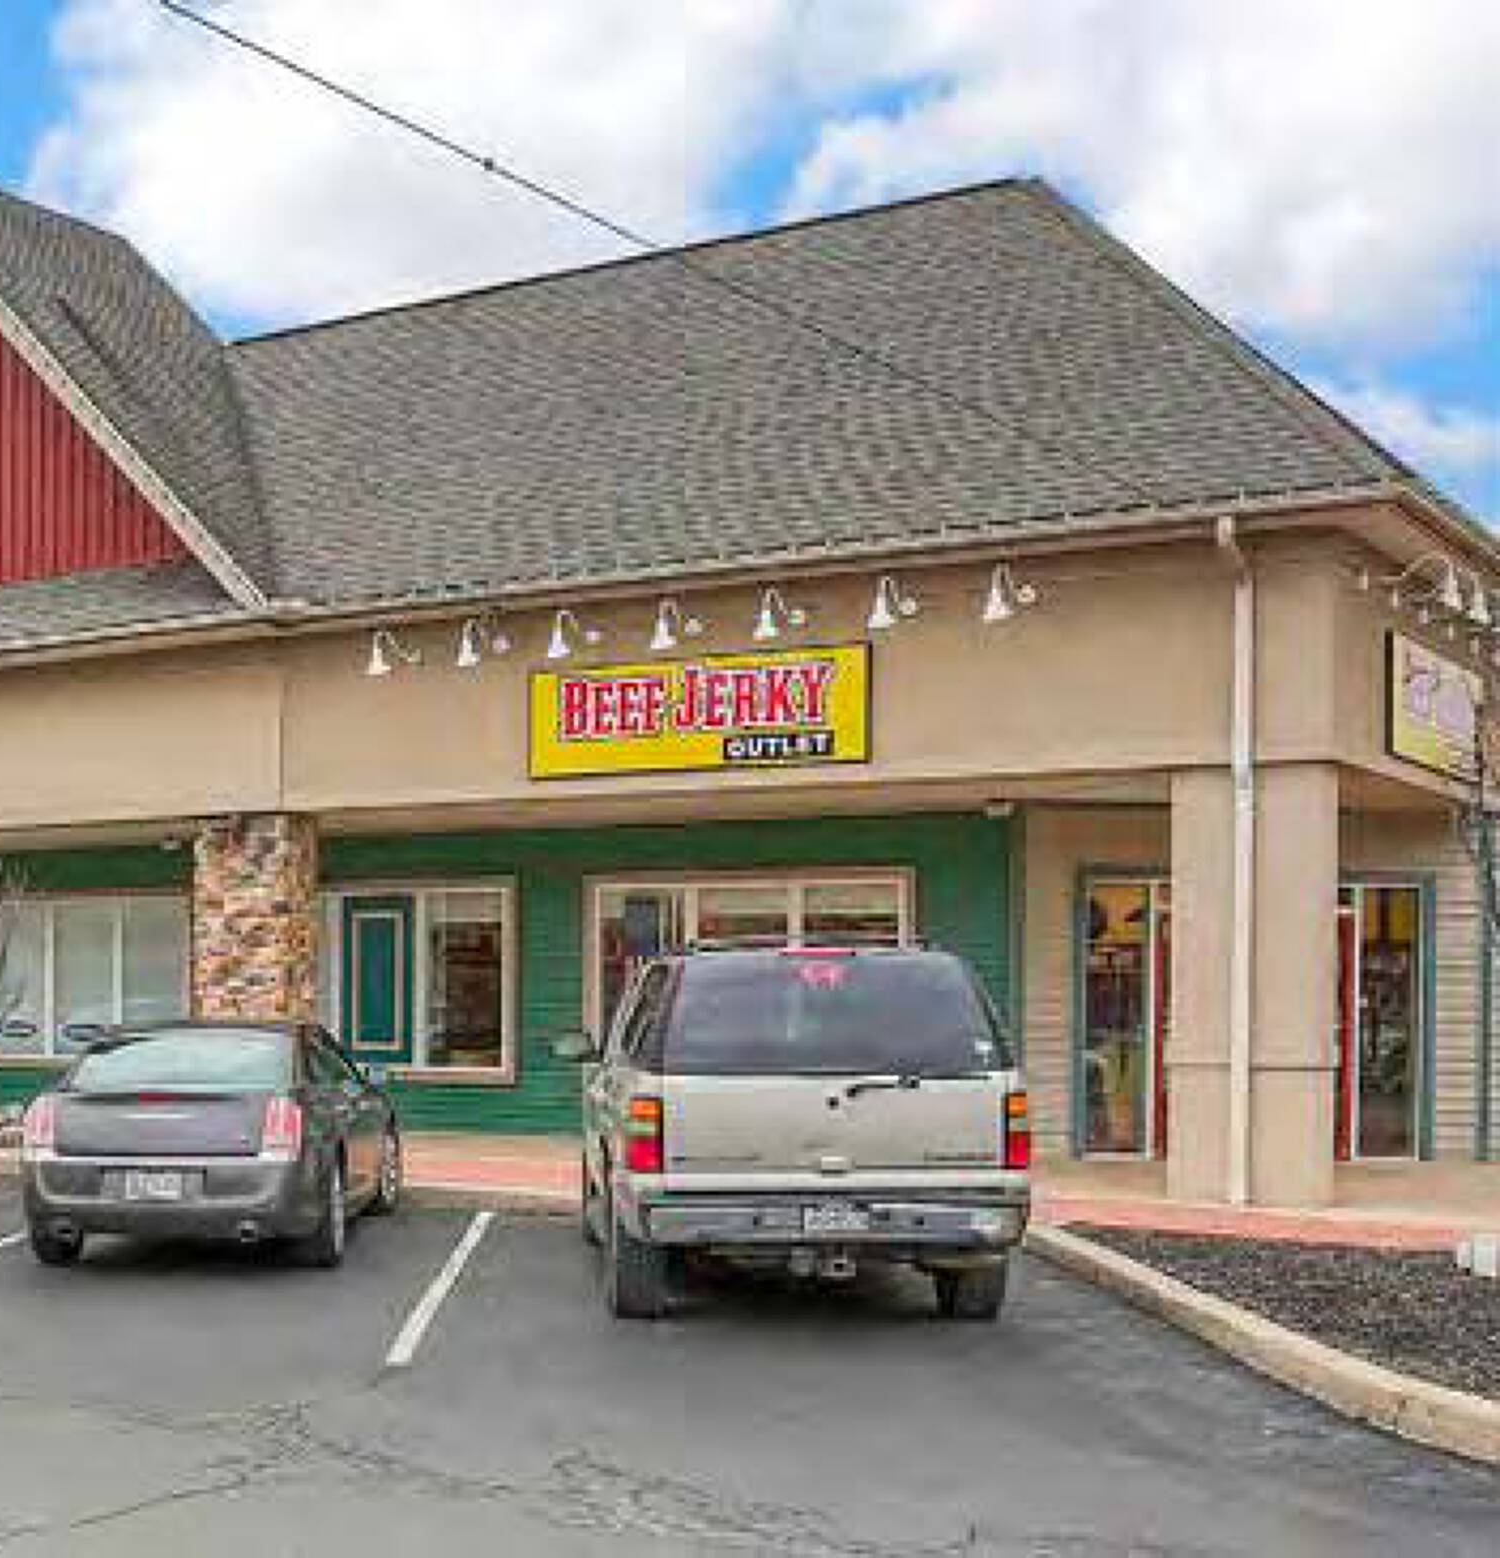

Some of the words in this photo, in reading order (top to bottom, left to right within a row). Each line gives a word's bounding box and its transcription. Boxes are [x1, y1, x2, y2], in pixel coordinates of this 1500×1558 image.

[560, 679, 665, 740] BEEF
[674, 664, 831, 730] JERKY
[727, 735, 828, 757] OUTLET
